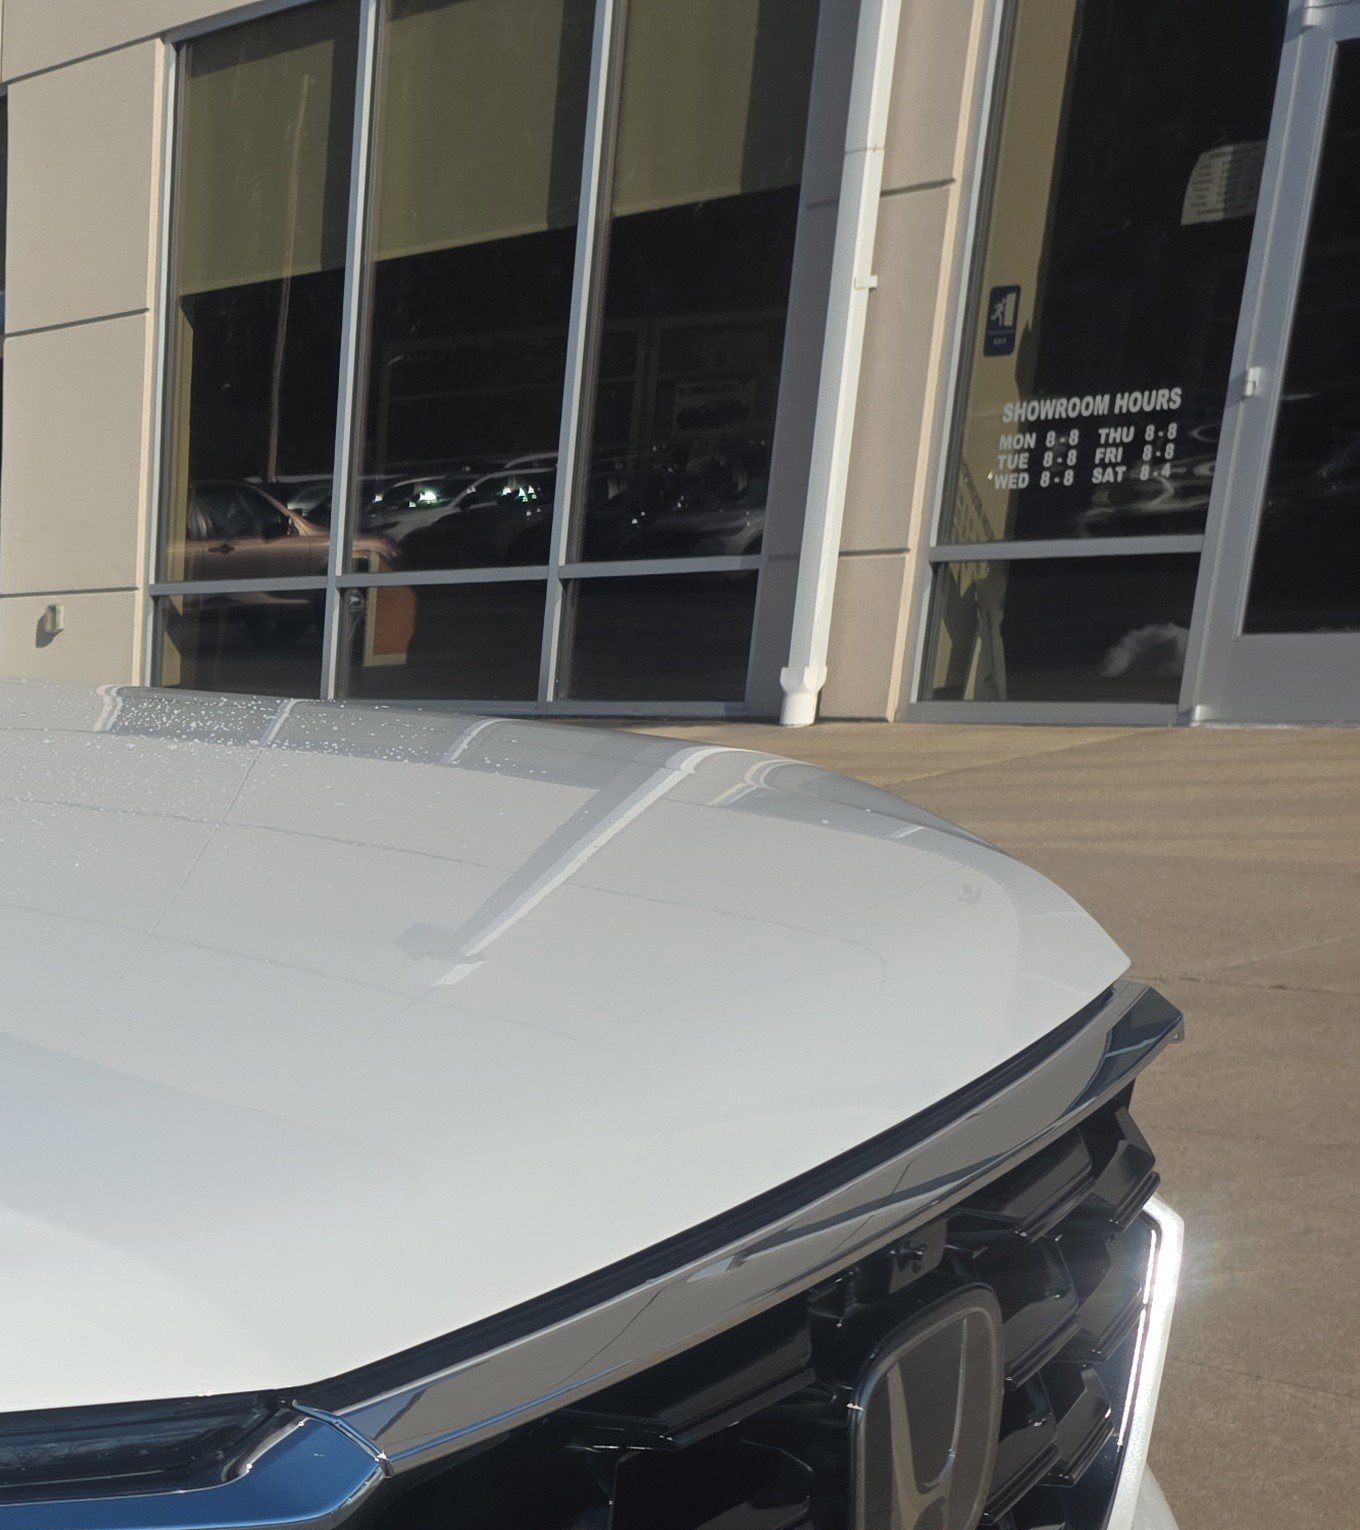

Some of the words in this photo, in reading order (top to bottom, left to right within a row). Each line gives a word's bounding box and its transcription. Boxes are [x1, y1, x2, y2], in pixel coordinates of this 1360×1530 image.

[1002, 394, 1110, 424] SHOWROOM
[1114, 387, 1182, 414] HOURS
[999, 432, 1036, 451] MON
[1098, 426, 1135, 444] THU
[996, 452, 1030, 470] TUE
[1094, 446, 1123, 464] FRI
[994, 472, 1030, 490] WED
[1091, 465, 1127, 484] SAT
